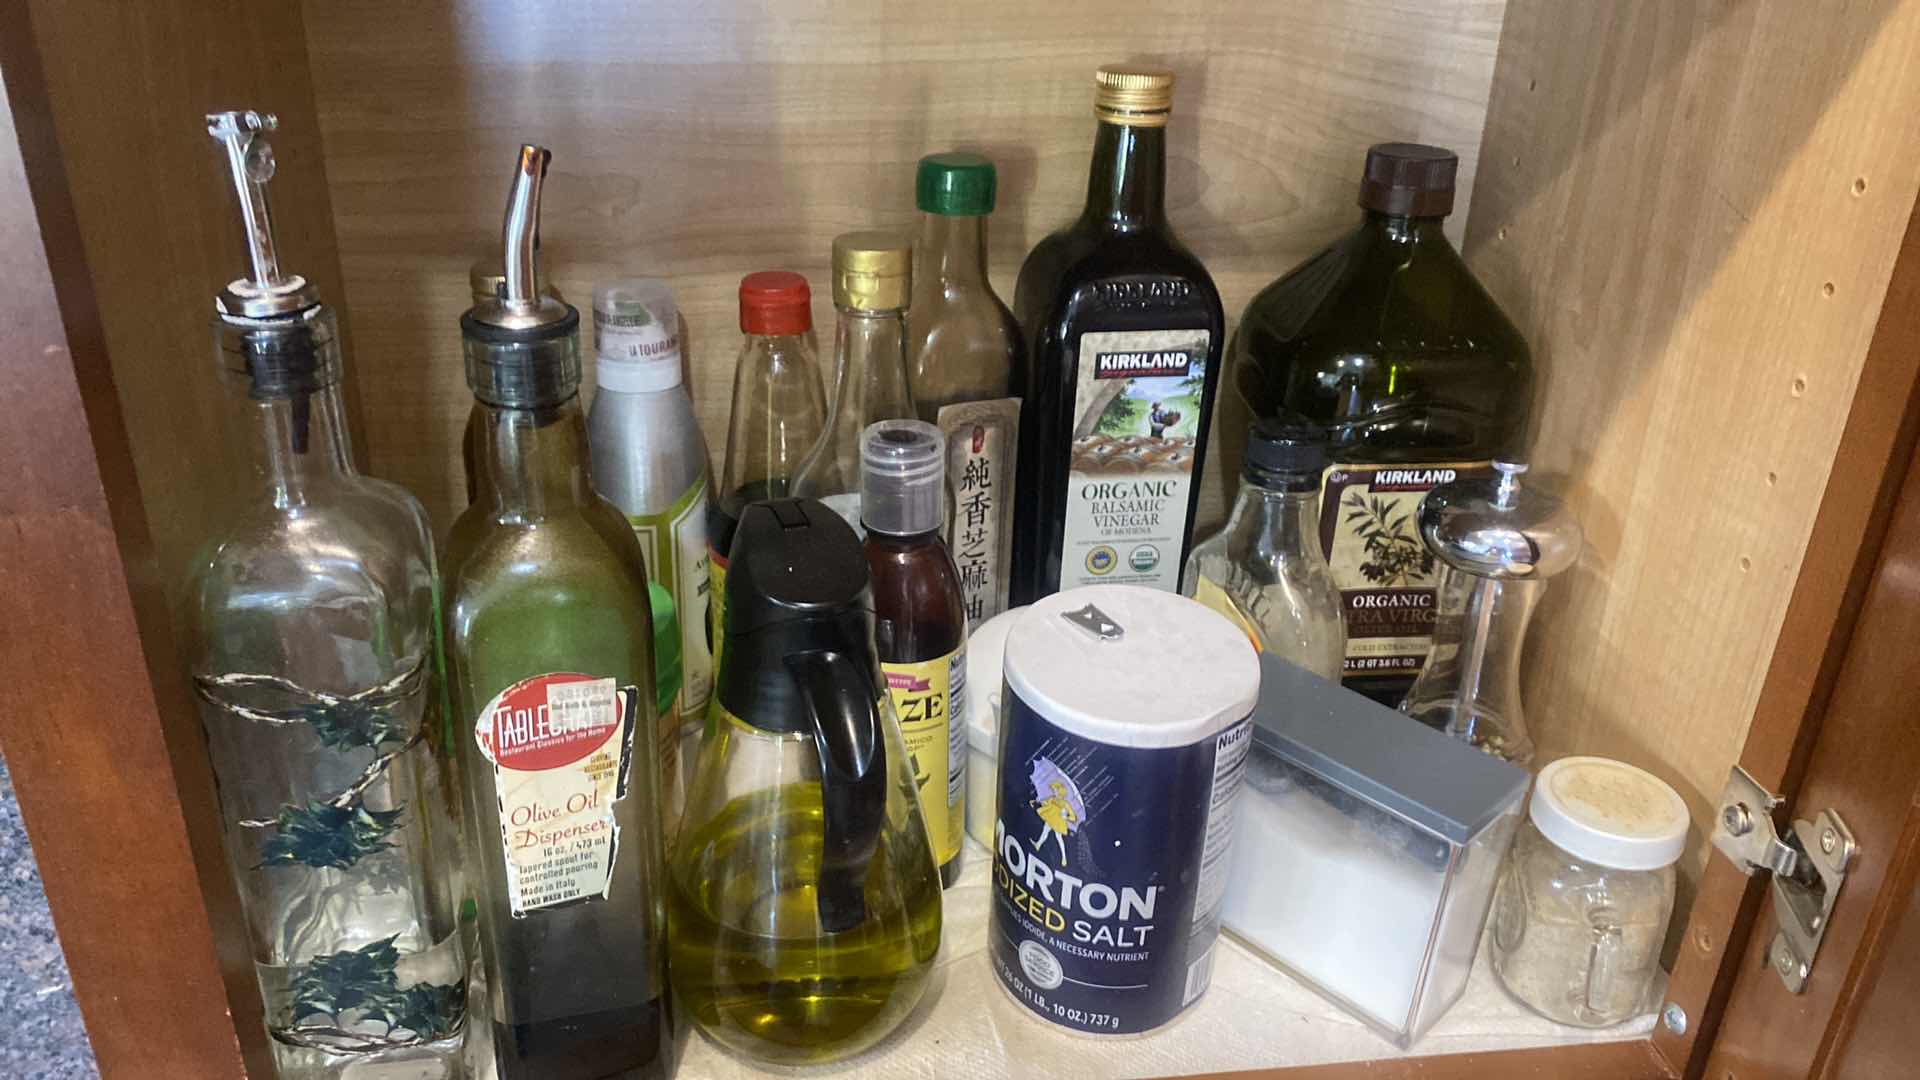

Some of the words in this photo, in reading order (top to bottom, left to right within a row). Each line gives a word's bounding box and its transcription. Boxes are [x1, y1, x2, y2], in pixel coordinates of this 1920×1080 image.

[1101, 352, 1188, 370] KIRKLAND
[1375, 469, 1456, 485] KIRKLAND
[1081, 480, 1177, 501] ORGANIC
[1091, 499, 1166, 515] BALSAMIC
[1094, 513, 1160, 528] VINEGAR
[1352, 594, 1432, 609] ORGANIC
[1389, 607, 1438, 624] VIRG
[901, 692, 943, 722] ZE
[497, 704, 594, 749] TABLE
[511, 802, 561, 827] Olive
[566, 789, 599, 814] Oil
[513, 820, 608, 850] Dispenser
[543, 848, 552, 857] 16
[576, 838, 592, 849] 473
[519, 861, 553, 874] tapered
[555, 853, 578, 867] spout
[580, 851, 593, 860] for
[519, 868, 563, 885] controlled
[565, 861, 598, 876] pouring
[520, 886, 543, 897] Made
[555, 878, 576, 890] Italy
[522, 898, 541, 908] HAND
[542, 893, 562, 904] WASH
[563, 889, 581, 899] ONLY
[1072, 920, 1154, 948] SALT
[1056, 940, 1105, 962] NECESSARY
[1106, 952, 1150, 962] NUTRIENT
[1014, 976, 1024, 993] OZ
[1024, 986, 1032, 1001] (1
[1053, 1003, 1065, 1017] 10
[1067, 1010, 1088, 1025] OZ.)
[1090, 1014, 1110, 1026] 737
[1112, 1016, 1119, 1028] g
